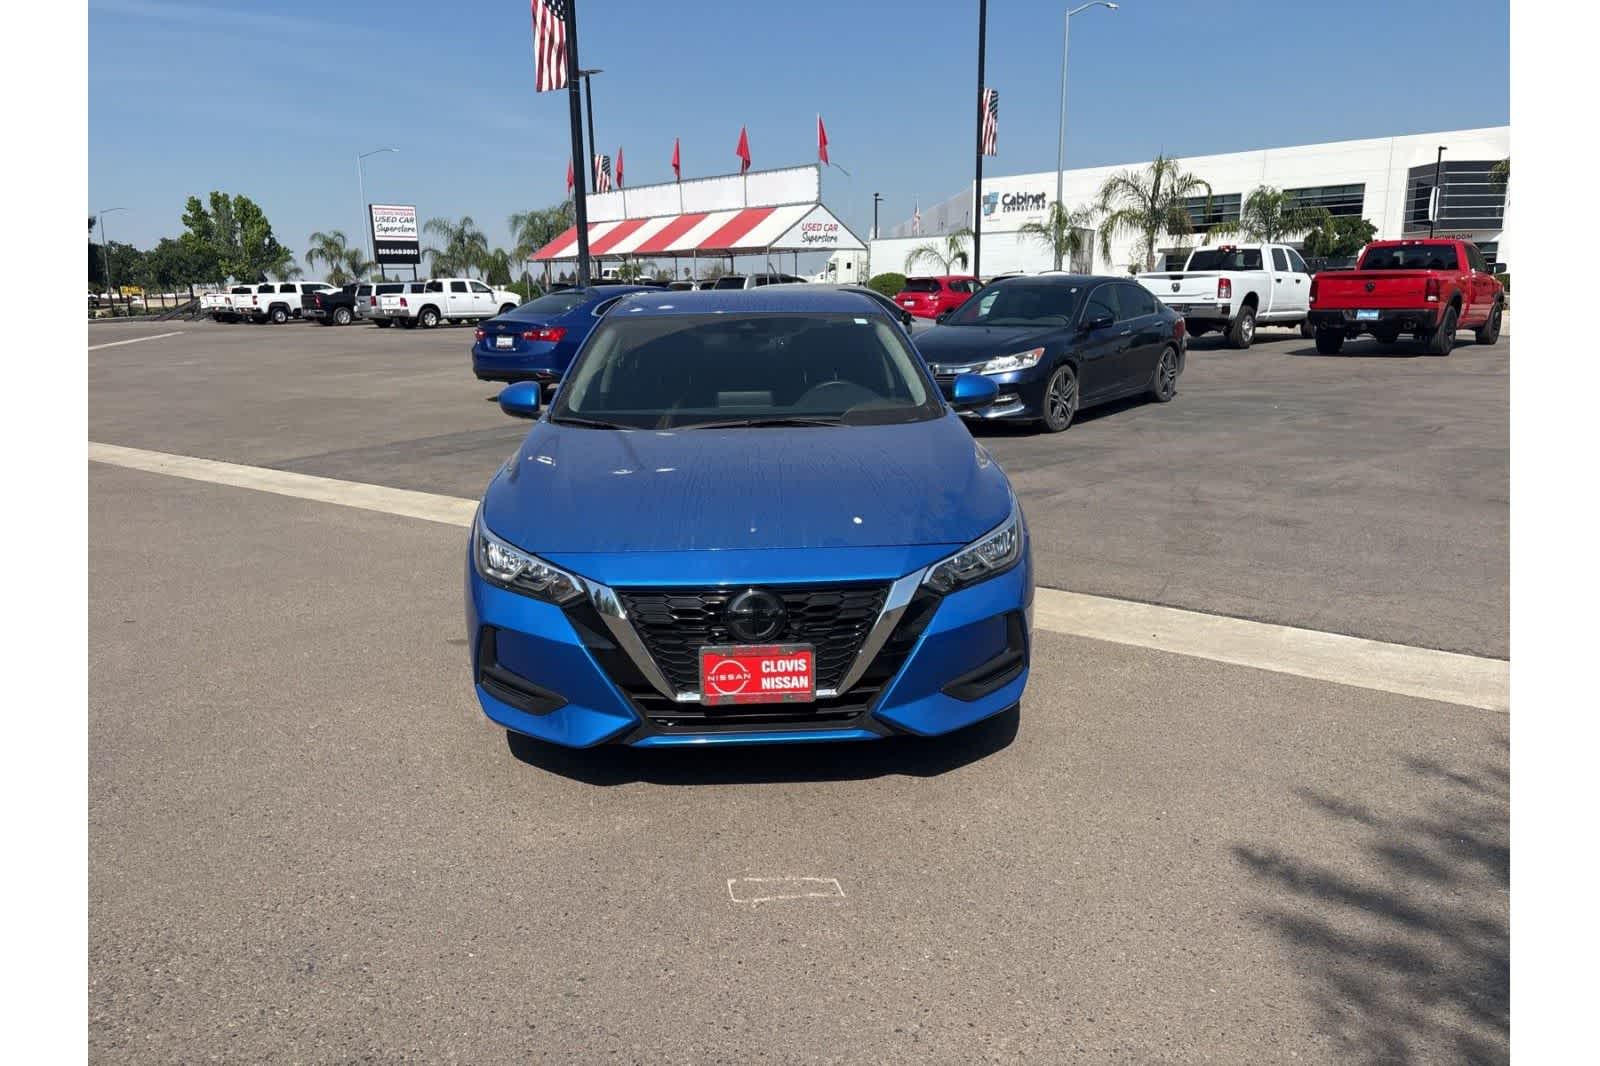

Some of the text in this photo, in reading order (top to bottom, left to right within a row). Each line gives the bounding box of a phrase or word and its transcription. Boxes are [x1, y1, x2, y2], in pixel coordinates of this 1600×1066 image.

[1001, 191, 1046, 206] Cabinet
[376, 223, 416, 234] Superstore
[801, 222, 839, 232] USED CAR
[801, 231, 838, 245] Superstore
[761, 658, 807, 673] CLOVIS
[707, 672, 751, 682] NISSAN
[761, 675, 809, 690] NISSAN
